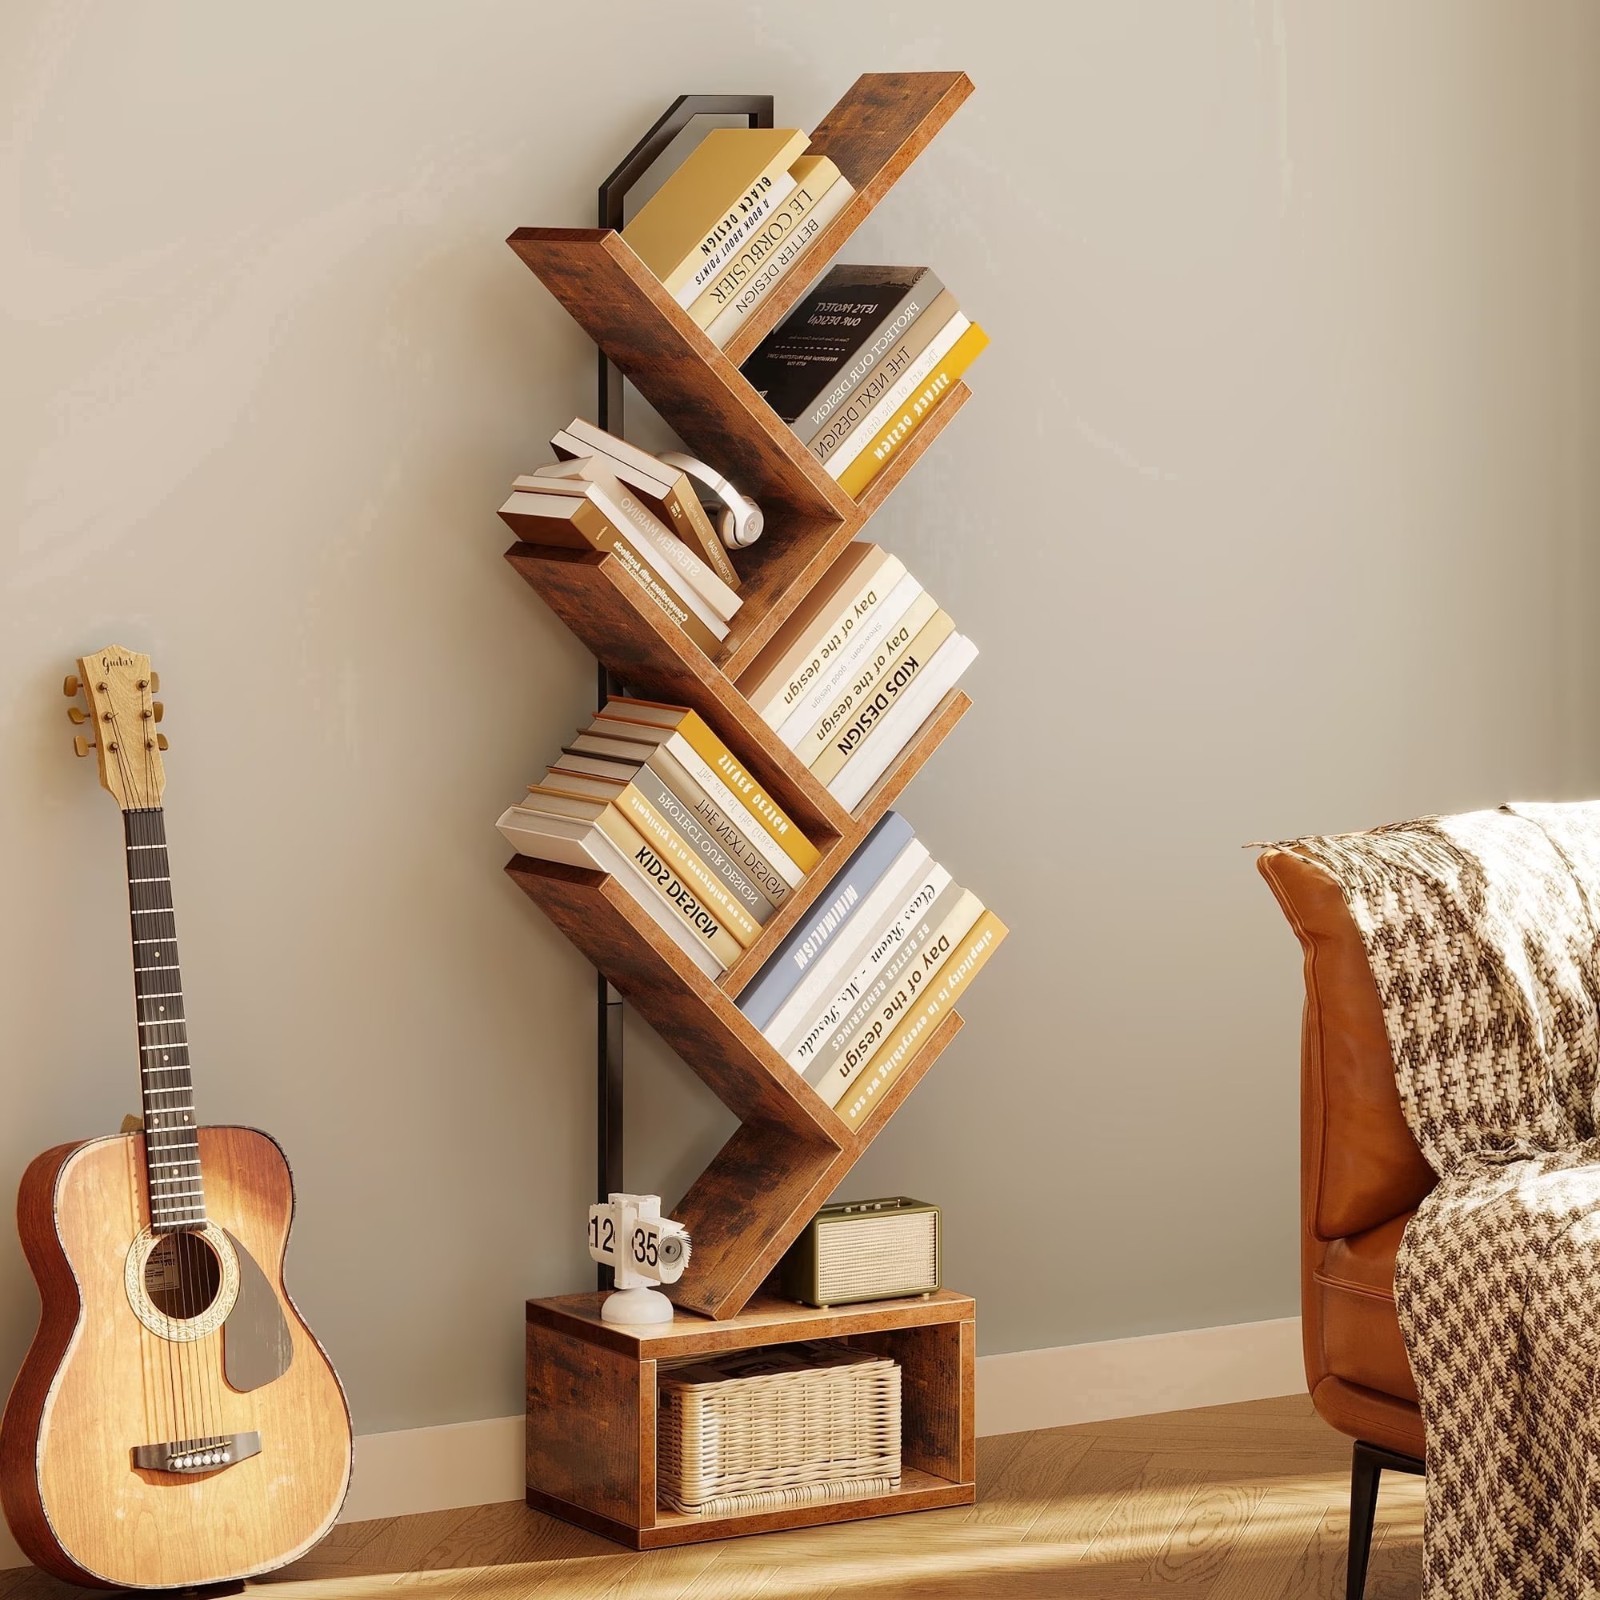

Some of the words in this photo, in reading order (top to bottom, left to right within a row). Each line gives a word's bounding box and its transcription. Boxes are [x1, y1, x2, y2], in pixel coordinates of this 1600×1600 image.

[738, 176, 772, 213] BLACK
[764, 198, 770, 209] A
[789, 188, 814, 216] LE
[701, 213, 739, 256] DESIGN
[743, 208, 764, 231] BOOK
[709, 212, 793, 304] CORBUSIER
[721, 230, 744, 257] ABOUT
[777, 218, 820, 266] BETTER
[695, 255, 721, 286] POINTS
[735, 263, 780, 314] DESIGN
[855, 591, 878, 620] Day
[841, 618, 854, 639] of
[850, 622, 883, 661] Showroom
[887, 627, 910, 656] Day
[822, 635, 842, 659] the
[783, 659, 822, 705] design
[831, 664, 847, 686] good
[854, 671, 875, 696] the
[873, 656, 886, 676] of
[885, 655, 920, 697] KIDS
[811, 684, 832, 709] design
[816, 696, 853, 742] design
[837, 693, 889, 756] DESIGN
[904, 883, 936, 921] Class
[793, 884, 859, 971] MINIMALISM
[870, 921, 906, 964] Room
[917, 923, 930, 941] BE
[885, 941, 919, 981] BETTER
[925, 935, 950, 971] Day
[947, 929, 994, 989] simplicity
[907, 970, 922, 995] of
[938, 985, 950, 1002] is
[831, 981, 887, 1051] RENDERINGS
[883, 989, 908, 1021] the
[927, 1001, 940, 1016] in
[797, 1004, 841, 1058] Posada
[878, 1015, 929, 1080] everything
[839, 1020, 884, 1079] design
[866, 1077, 881, 1096] we
[849, 1096, 867, 1119] see
[591, 1215, 614, 1254] 12
[634, 1228, 658, 1267] 35
